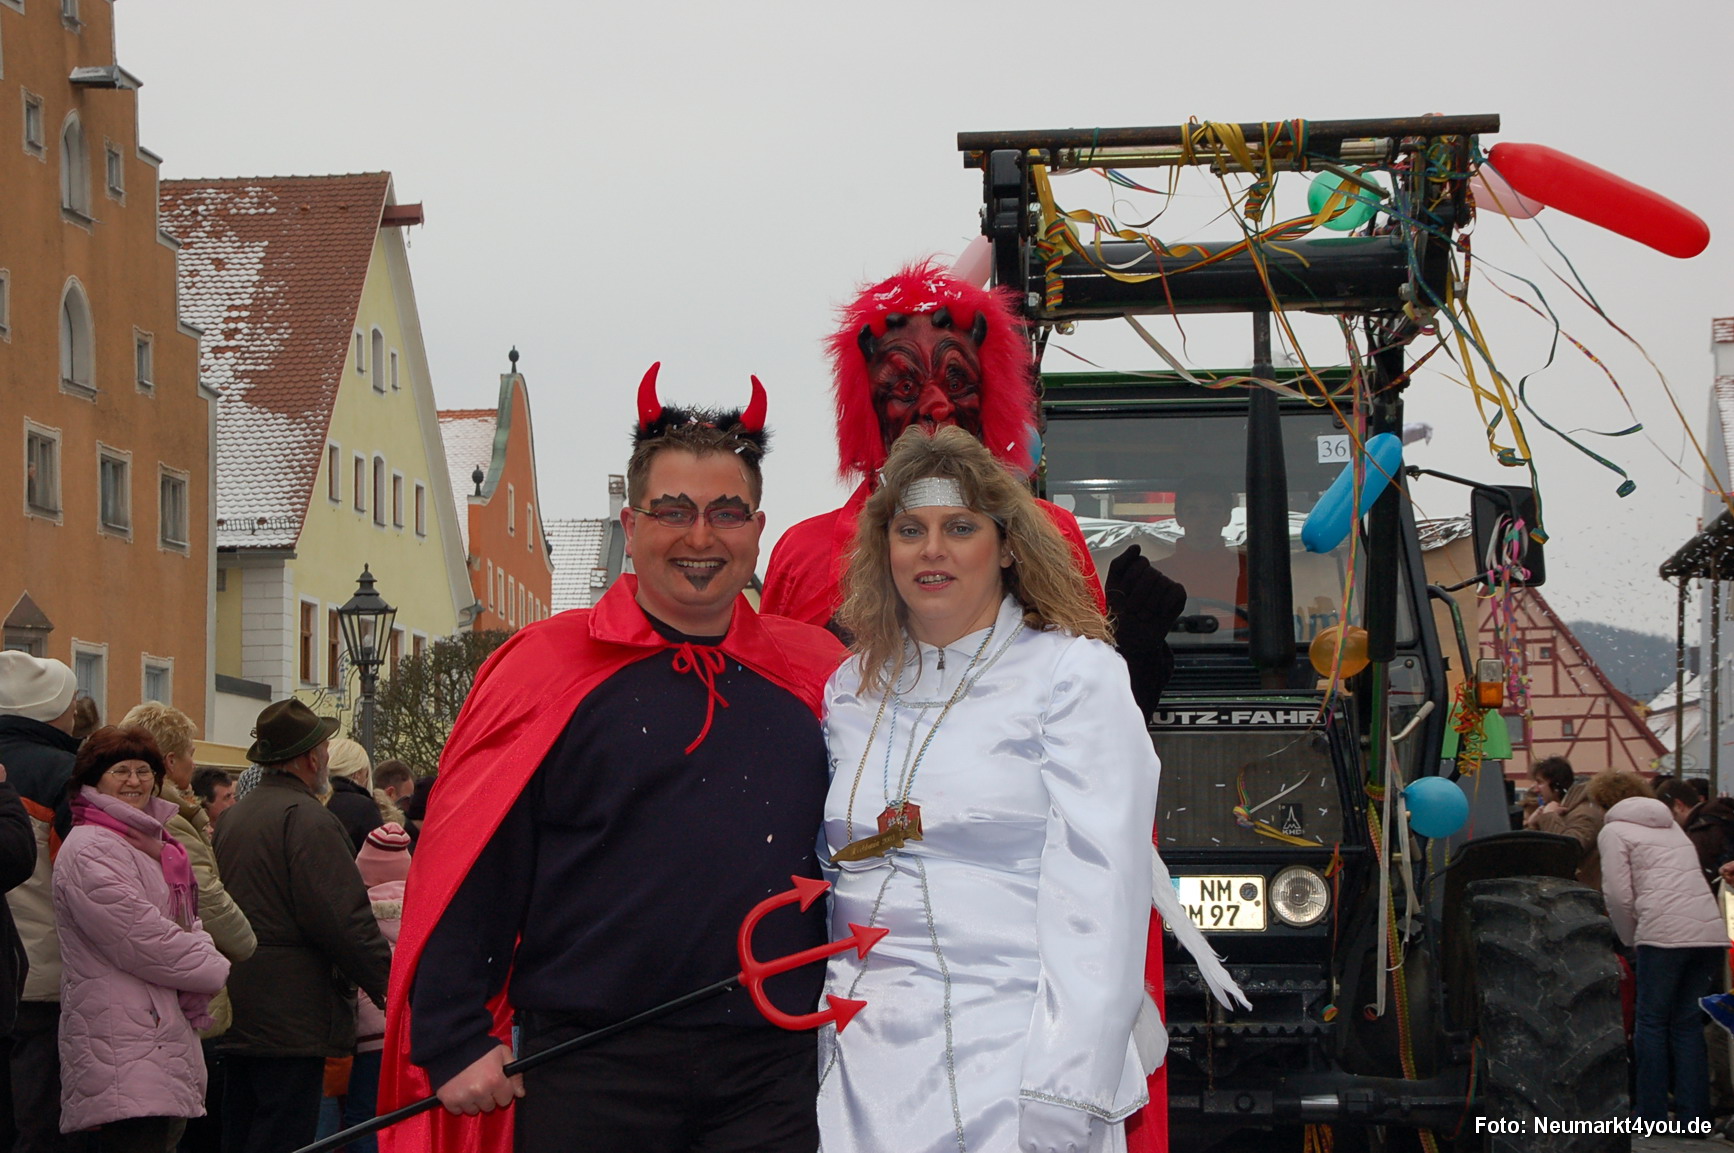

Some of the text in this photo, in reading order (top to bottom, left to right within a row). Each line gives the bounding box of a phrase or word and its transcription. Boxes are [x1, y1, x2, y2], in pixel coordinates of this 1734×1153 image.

[1321, 440, 1346, 458] 36
[1150, 710, 1321, 724] UTZ-FAHR
[1200, 880, 1232, 902] NM
[1181, 904, 1240, 926] M 97
